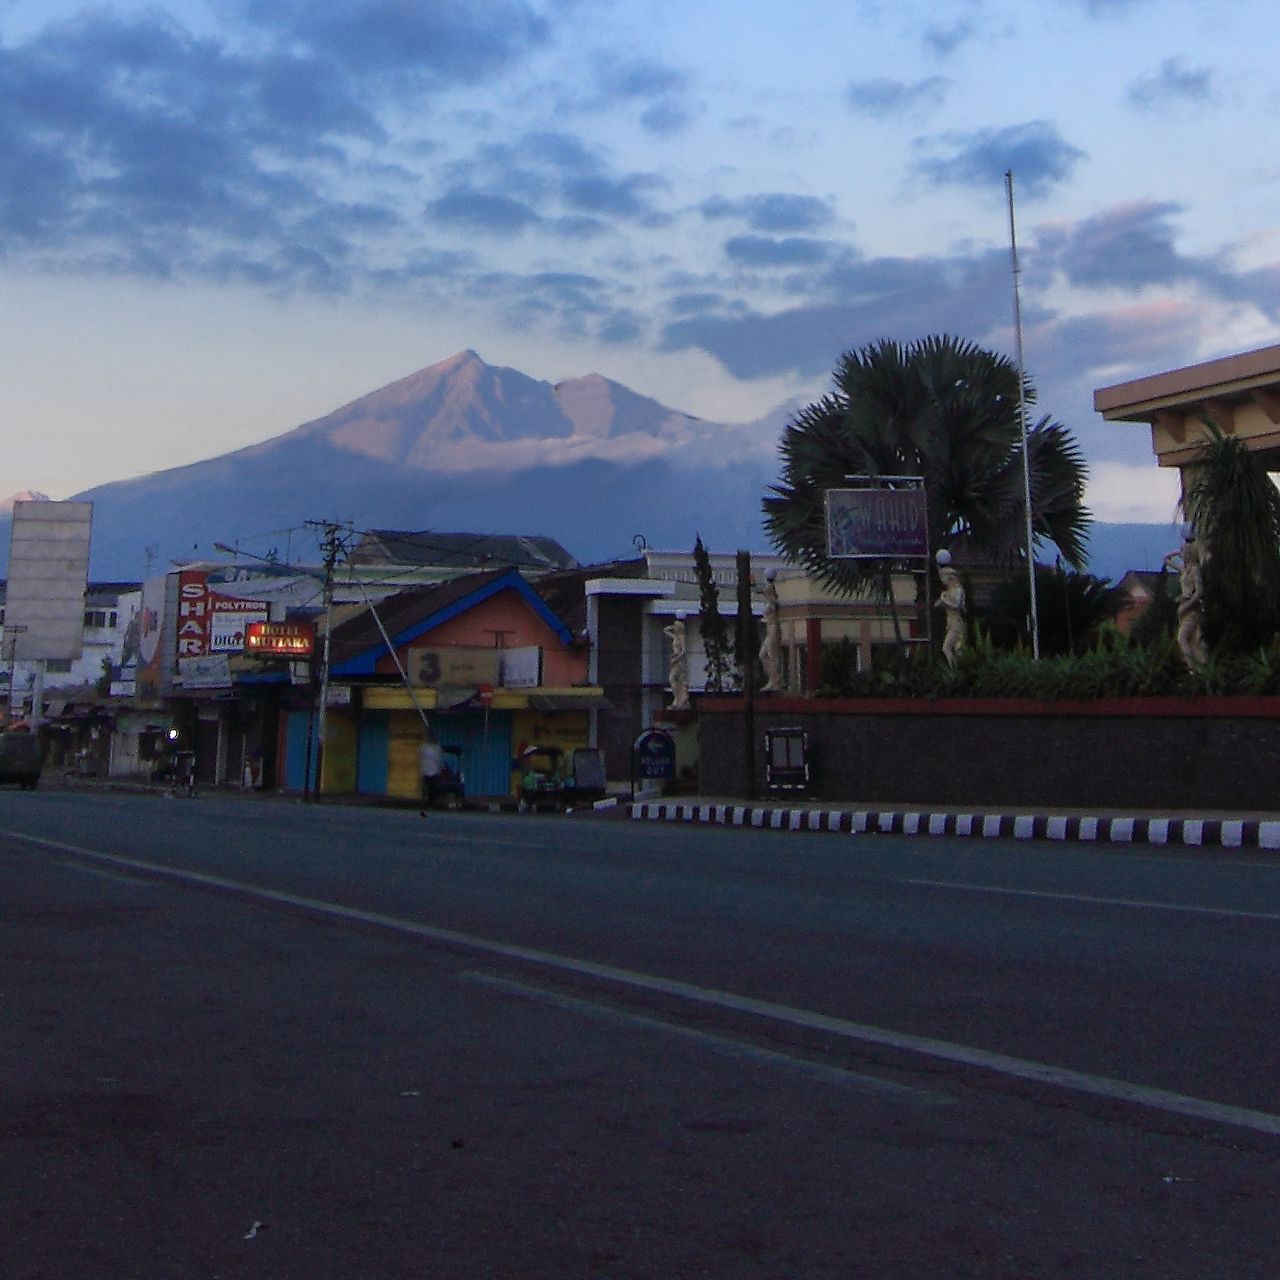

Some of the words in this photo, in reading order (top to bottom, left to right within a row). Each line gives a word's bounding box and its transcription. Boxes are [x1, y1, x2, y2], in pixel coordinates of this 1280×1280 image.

[214, 601, 267, 611] POLYTRON
[260, 625, 301, 635] HOTEL
[250, 635, 310, 649] MUTIARA
[419, 652, 441, 683] 3
